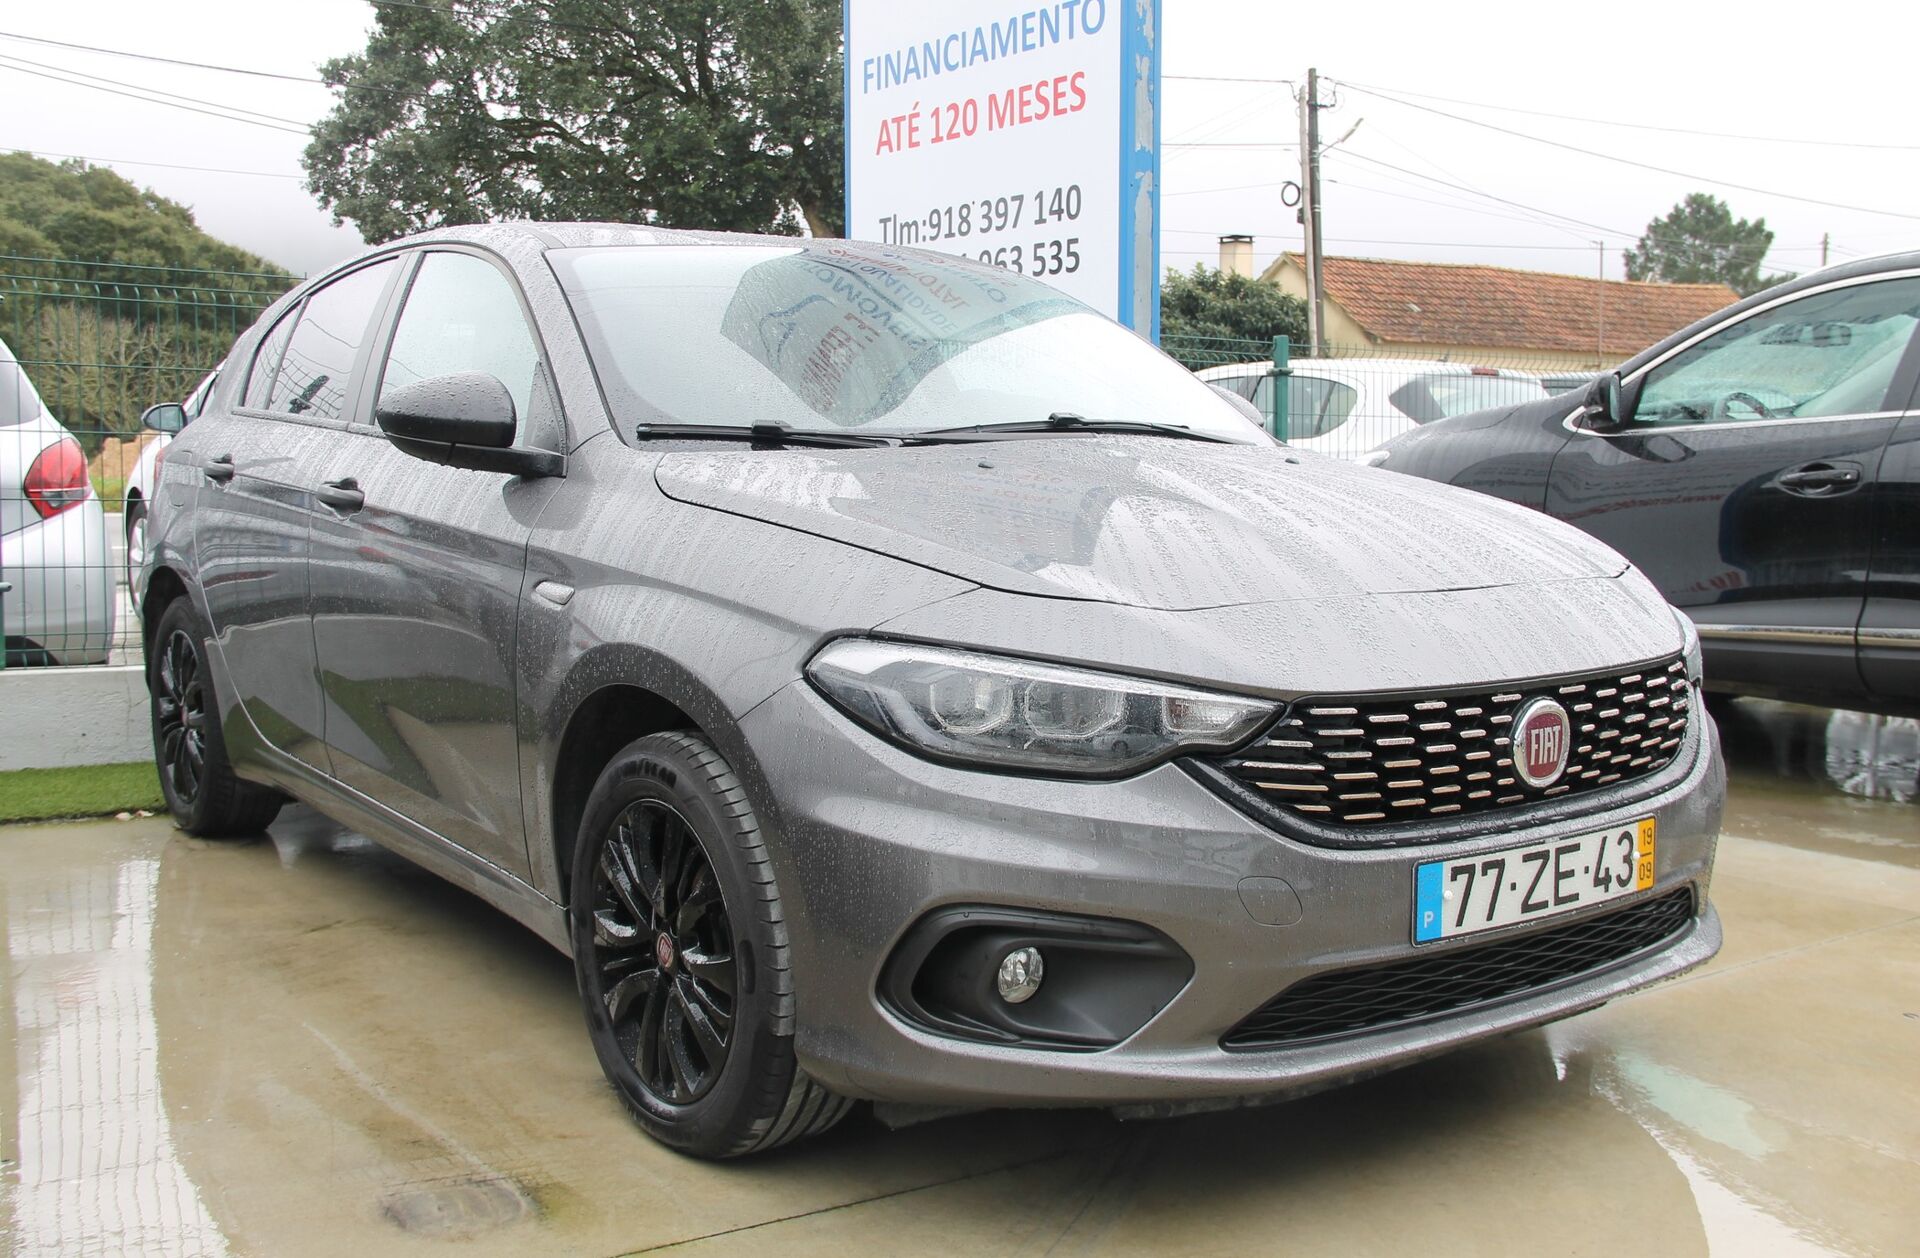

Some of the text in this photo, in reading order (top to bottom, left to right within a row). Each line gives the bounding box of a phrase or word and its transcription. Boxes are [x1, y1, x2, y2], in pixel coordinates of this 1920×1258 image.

[864, 0, 1106, 94] FINANCIAMENTO
[876, 71, 1087, 156] ATÉ 120 MESES
[979, 194, 1024, 234] 397
[1034, 184, 1082, 226] 140
[1032, 237, 1081, 278] 535
[1530, 724, 1562, 767] FIAT
[1642, 826, 1653, 847] 19
[1638, 861, 1652, 882] 09
[1423, 910, 1435, 928] P
